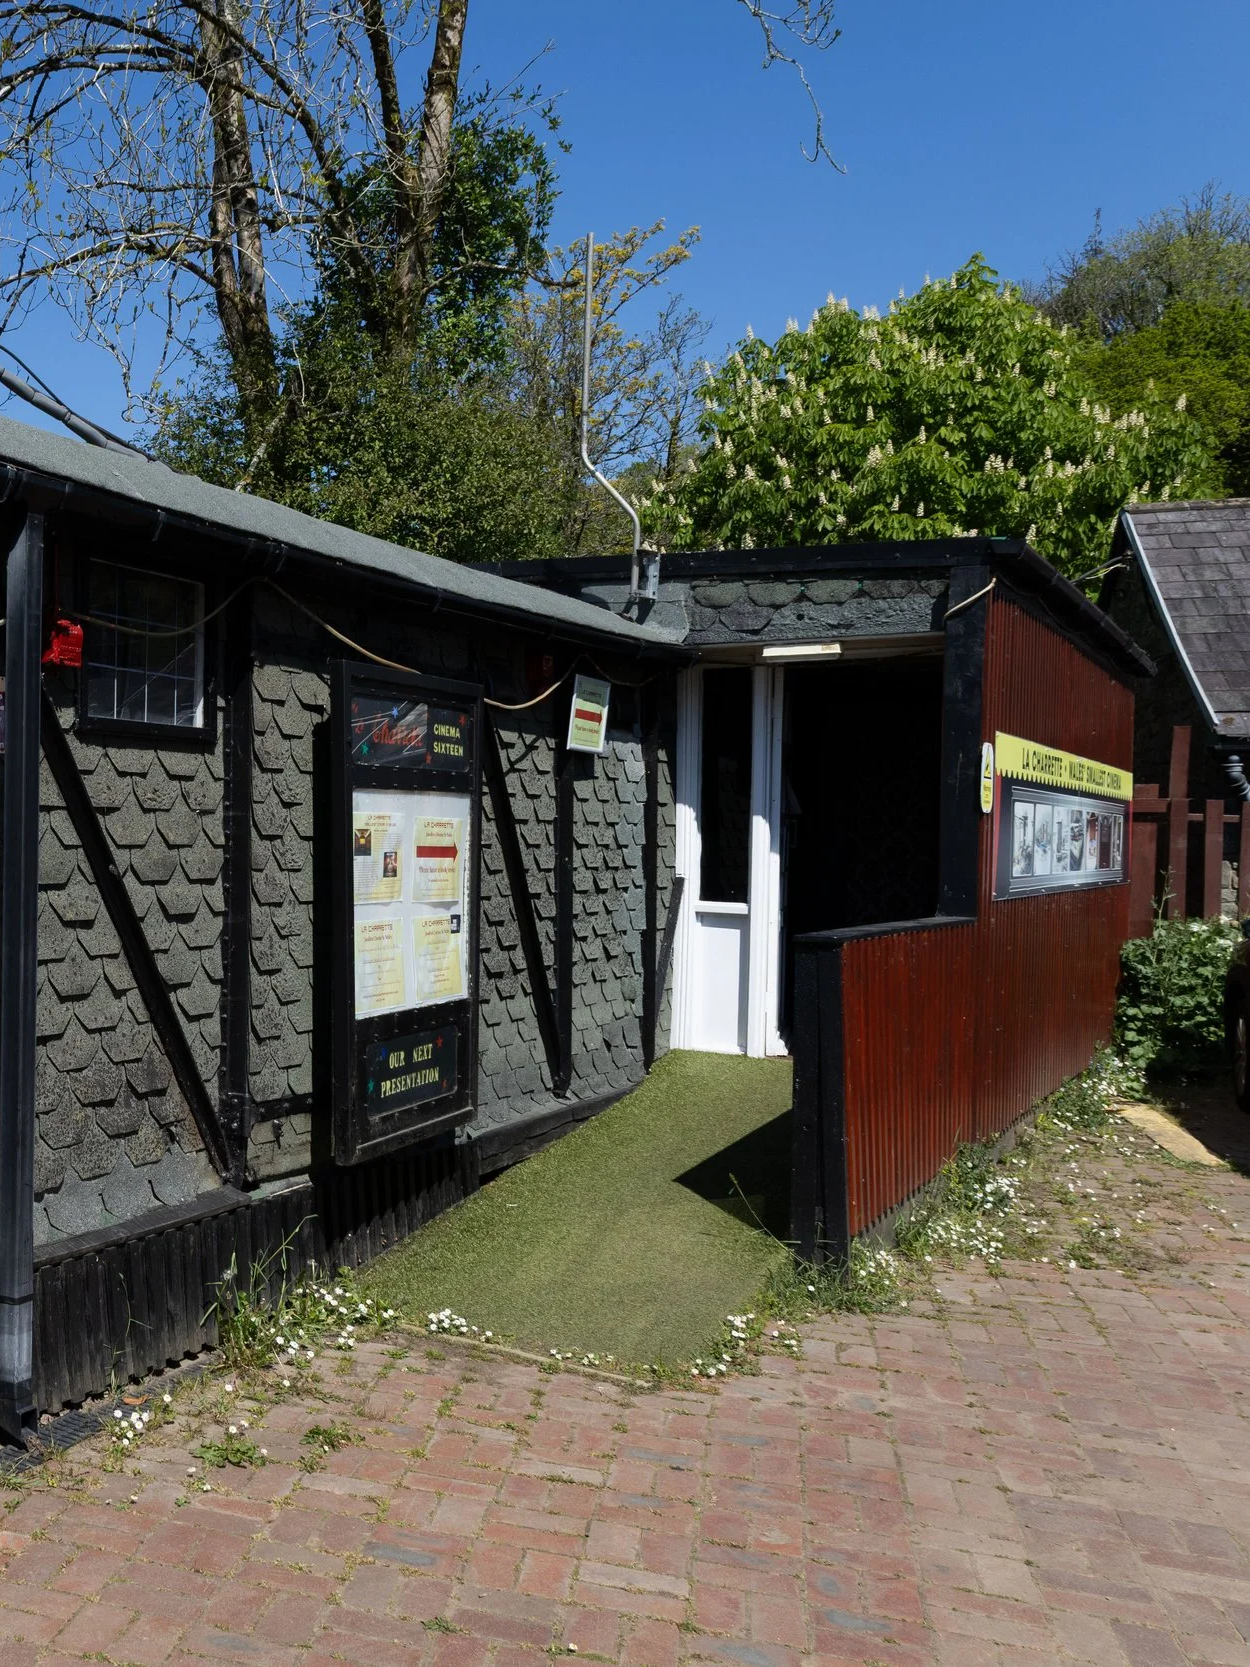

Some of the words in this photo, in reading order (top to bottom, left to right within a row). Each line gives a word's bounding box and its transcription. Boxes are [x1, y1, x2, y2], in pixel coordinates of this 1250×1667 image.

[433, 723, 461, 739] CINEMA
[433, 741, 464, 757] SIXTEEN
[1022, 747, 1030, 770] LA
[1031, 750, 1063, 778] CHARRETTE
[1086, 765, 1106, 787] SMALLEST
[1107, 771, 1121, 791] CINEMA
[389, 1051, 405, 1069] OUR
[412, 1043, 433, 1063] NEXT
[380, 1067, 440, 1099] PRESENTATION
